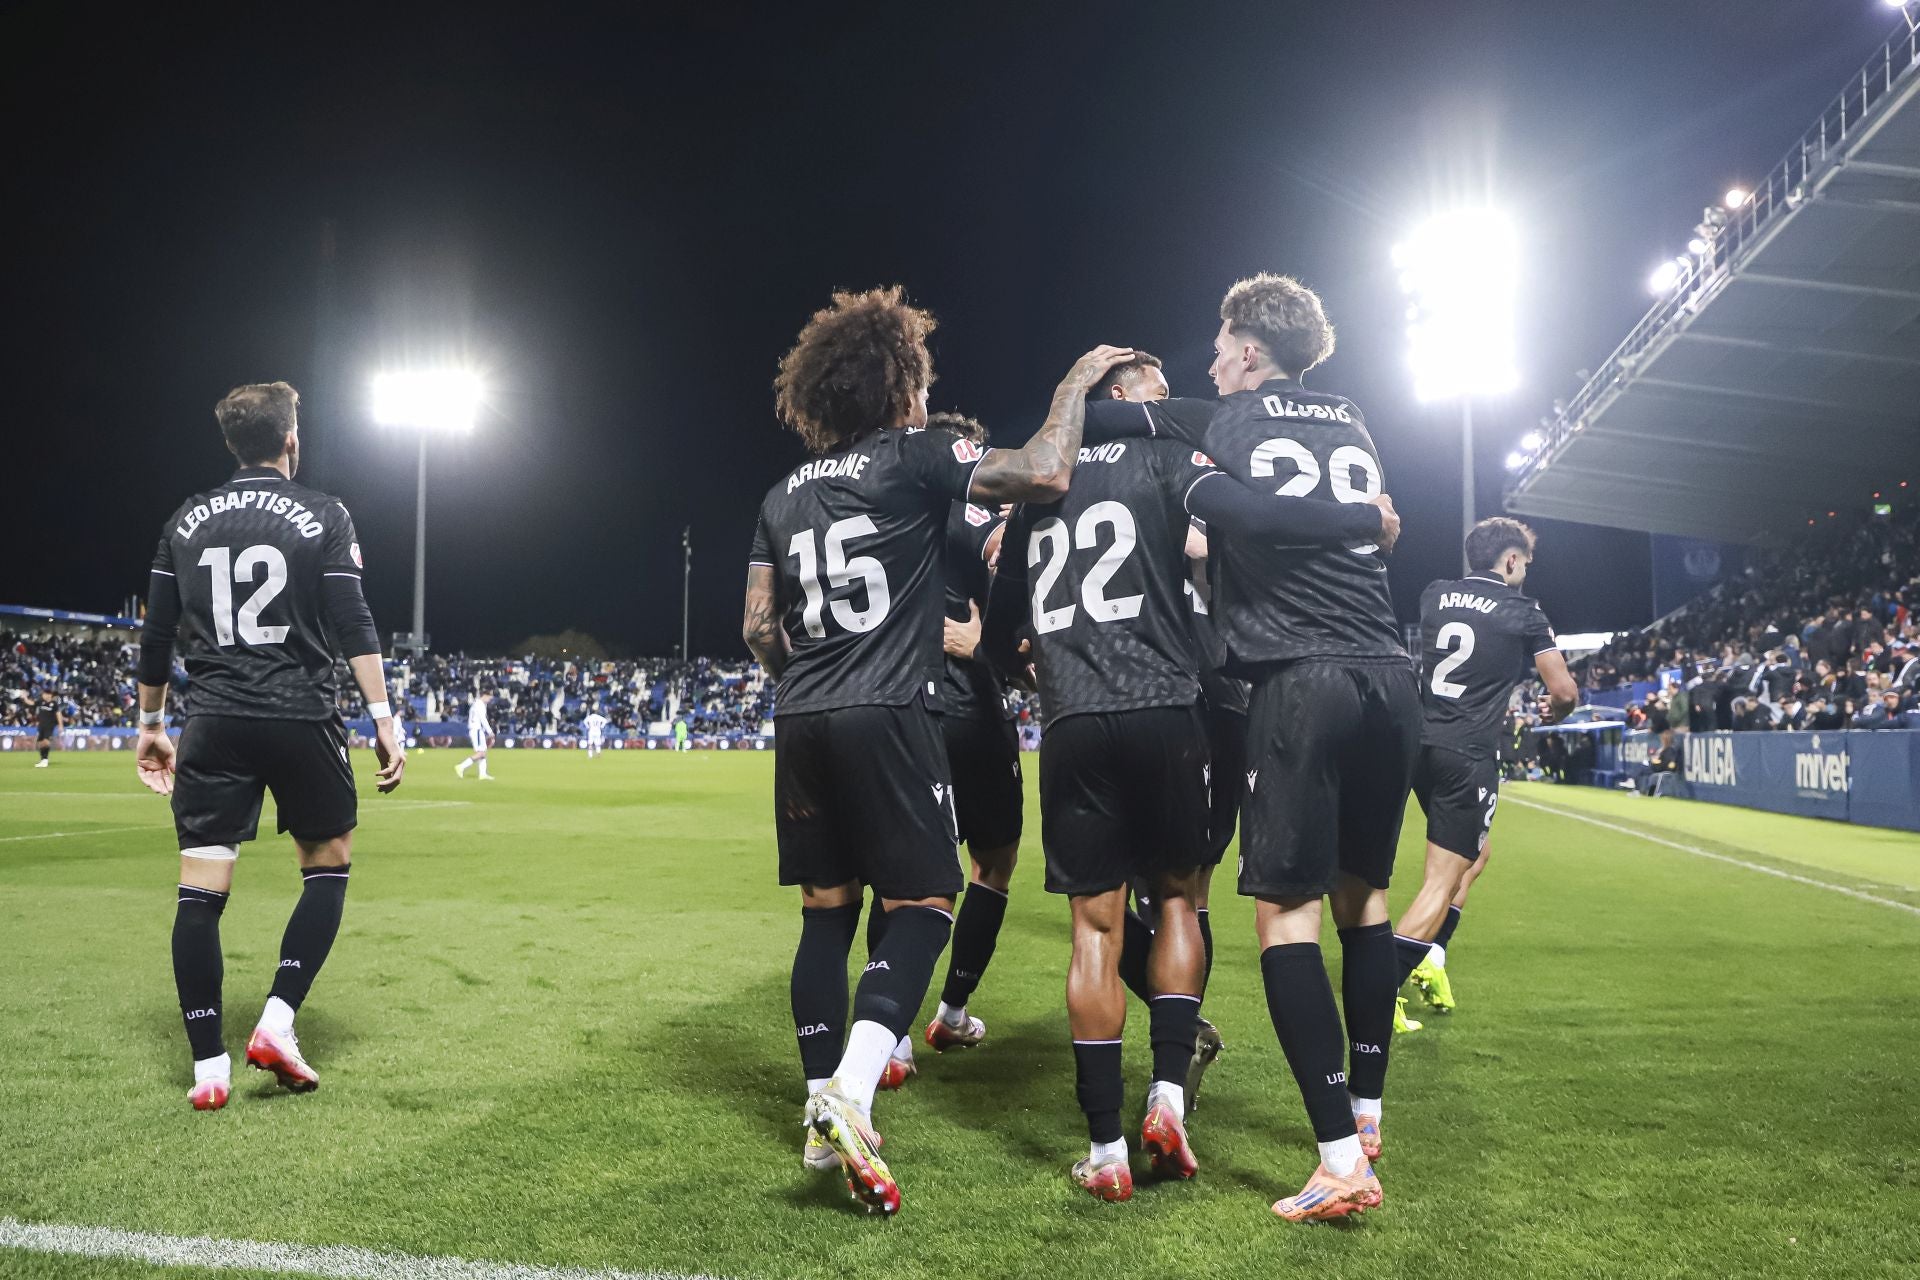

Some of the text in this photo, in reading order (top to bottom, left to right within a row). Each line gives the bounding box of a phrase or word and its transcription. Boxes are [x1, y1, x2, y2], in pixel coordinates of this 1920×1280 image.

[1076, 443, 1126, 466] RINO
[787, 454, 870, 494] ARIDANE
[177, 504, 210, 539] LEO
[788, 514, 890, 639] 15
[1027, 501, 1144, 634] 22
[198, 545, 290, 646] 12
[1439, 593, 1497, 614] ARNAU
[1431, 622, 1475, 698] 2
[1683, 733, 1736, 786] LALIGA
[186, 1008, 217, 1020] UDA
[797, 1023, 829, 1036] UDA
[1352, 1042, 1381, 1053] UDA
[1326, 1072, 1345, 1084] UD
